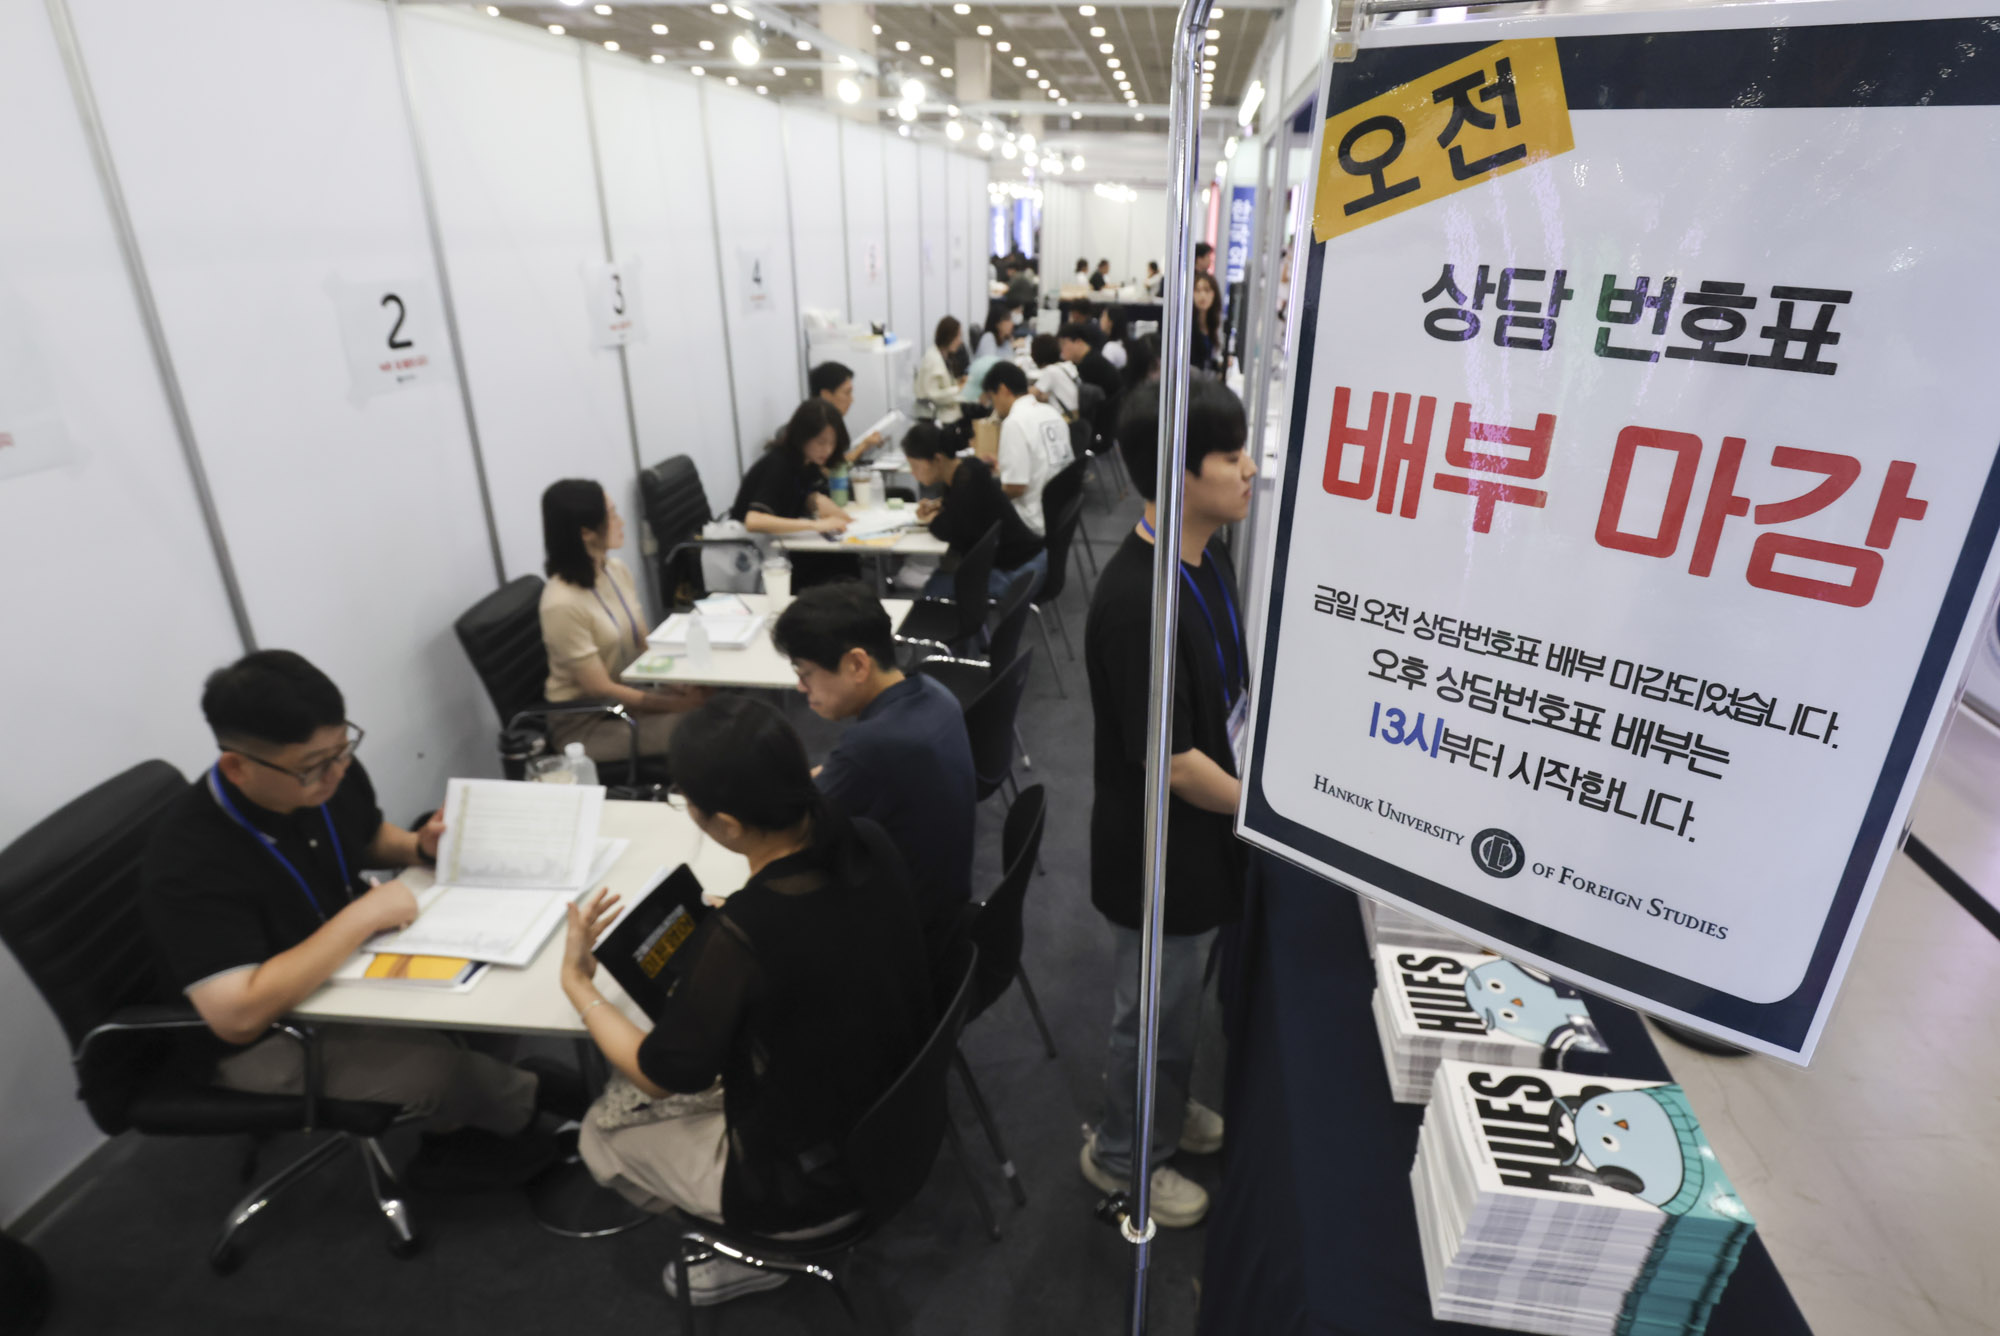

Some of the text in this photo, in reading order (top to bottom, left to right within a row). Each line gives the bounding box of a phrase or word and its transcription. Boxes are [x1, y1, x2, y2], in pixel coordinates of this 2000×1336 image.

[1338, 57, 1527, 216] 오전
[381, 293, 413, 349] 2
[1421, 263, 1853, 375] 상담 번호표
[1322, 386, 1929, 608] 배부 마감
[1314, 584, 1839, 750] 금일 오전 상담번호표 배부 마감되었습니다.
[1368, 649, 1730, 780] 오후 상담번호표 배부는
[1369, 701, 1696, 843] 13시부터 시작합니다.
[1313, 773, 1374, 813] HANKUK
[1378, 799, 1465, 846] UNIVERSITY
[1558, 866, 1643, 910] FOREIGN
[1646, 898, 1729, 940] STUDIES
